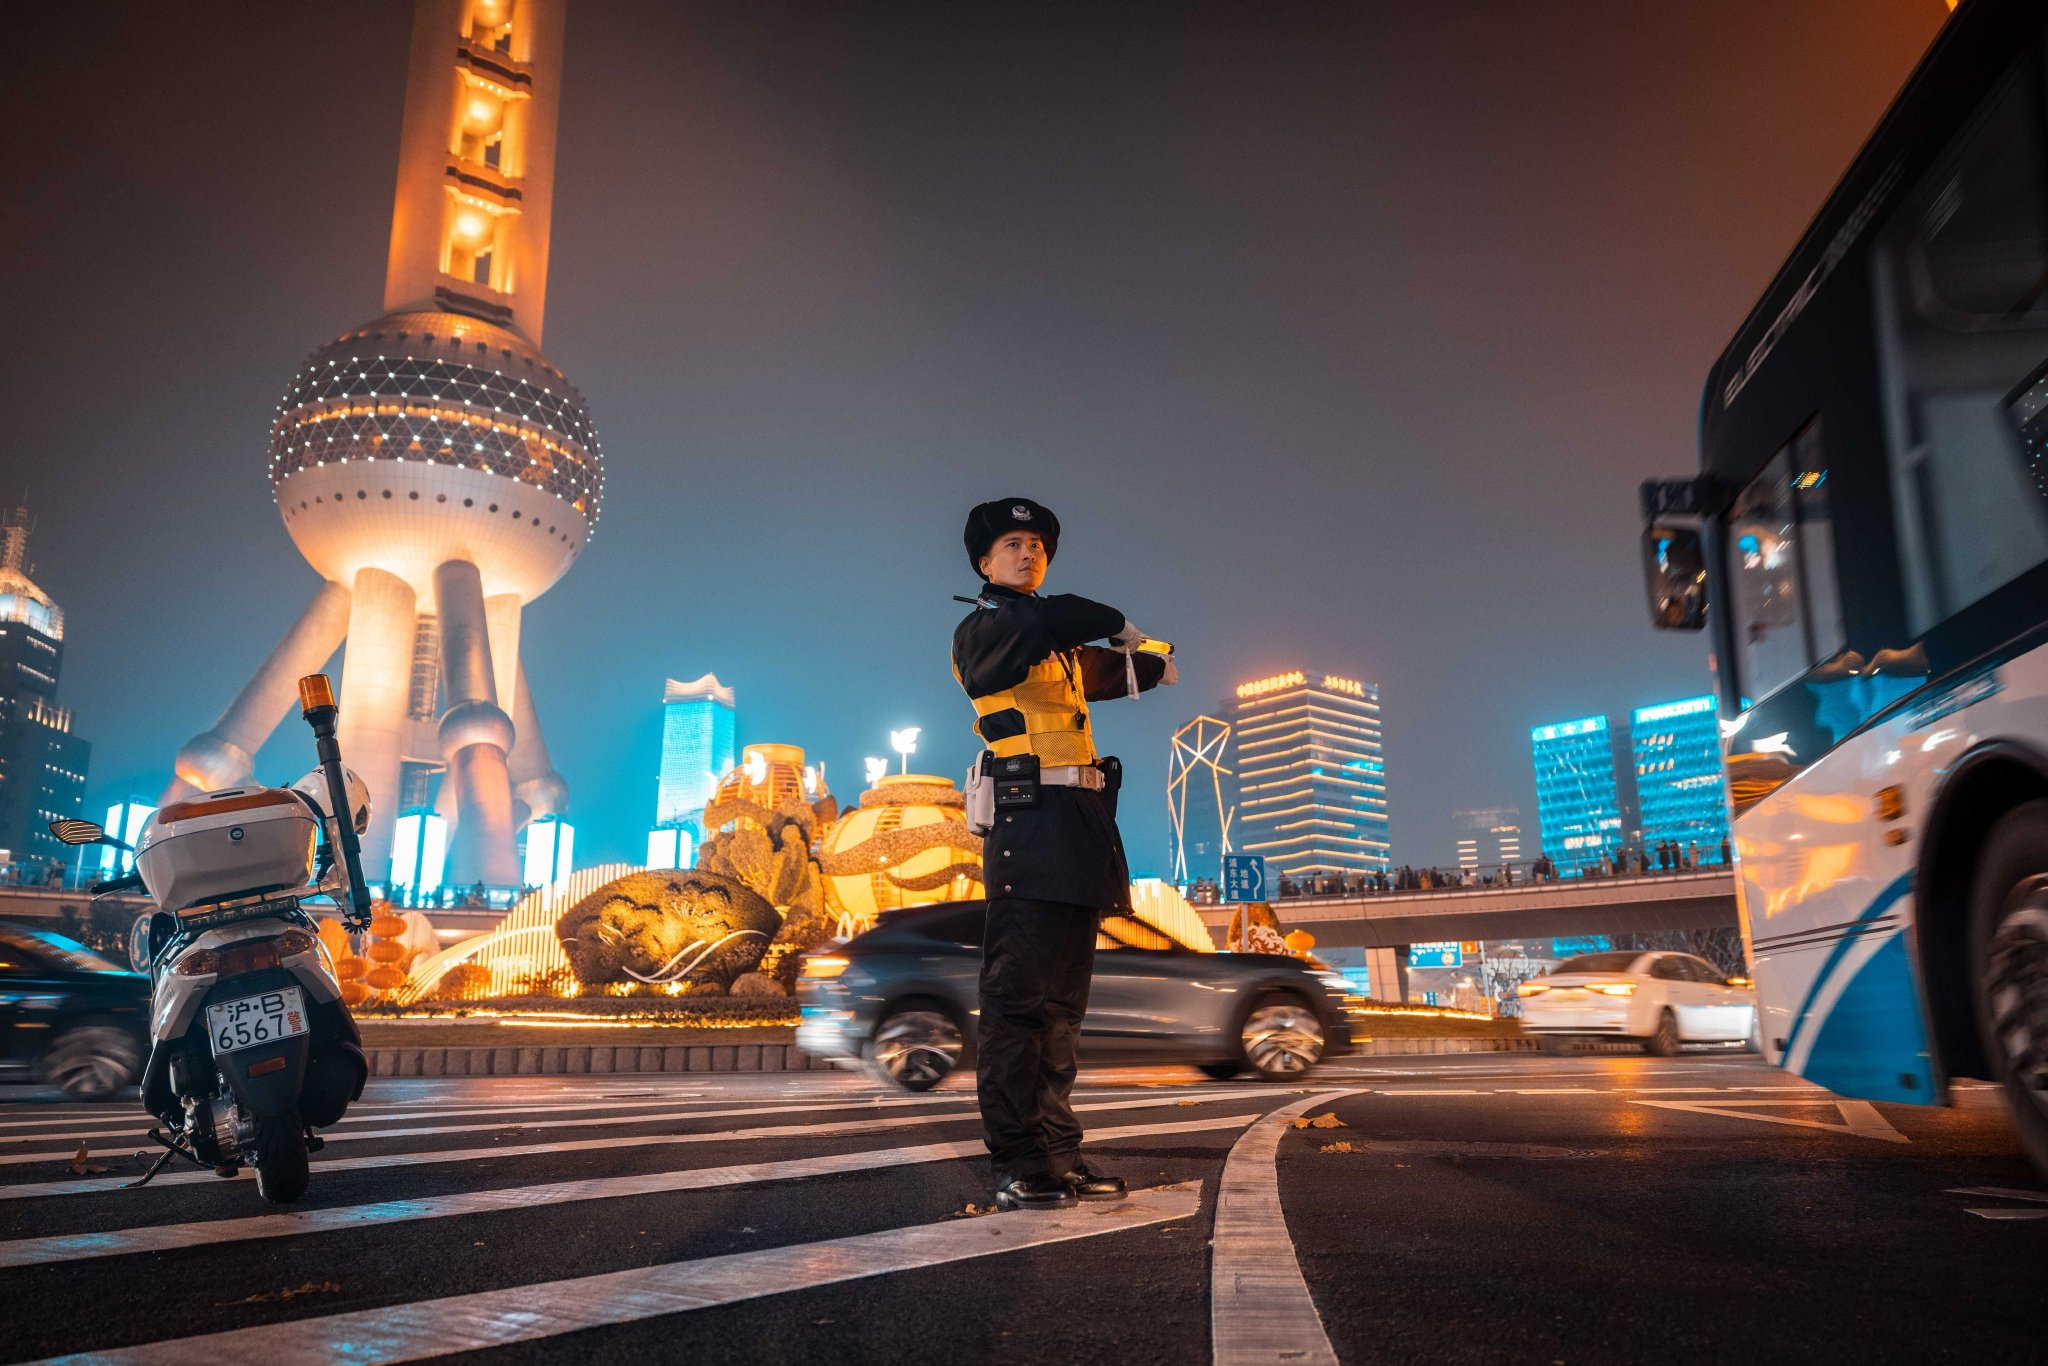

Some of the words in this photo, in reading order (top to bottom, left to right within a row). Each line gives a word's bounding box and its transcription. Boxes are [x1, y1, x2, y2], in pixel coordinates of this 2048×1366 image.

[1229, 858, 1239, 900] 浦东大道
[218, 1014, 284, 1050] 6567
[287, 1010, 302, 1033] 警
